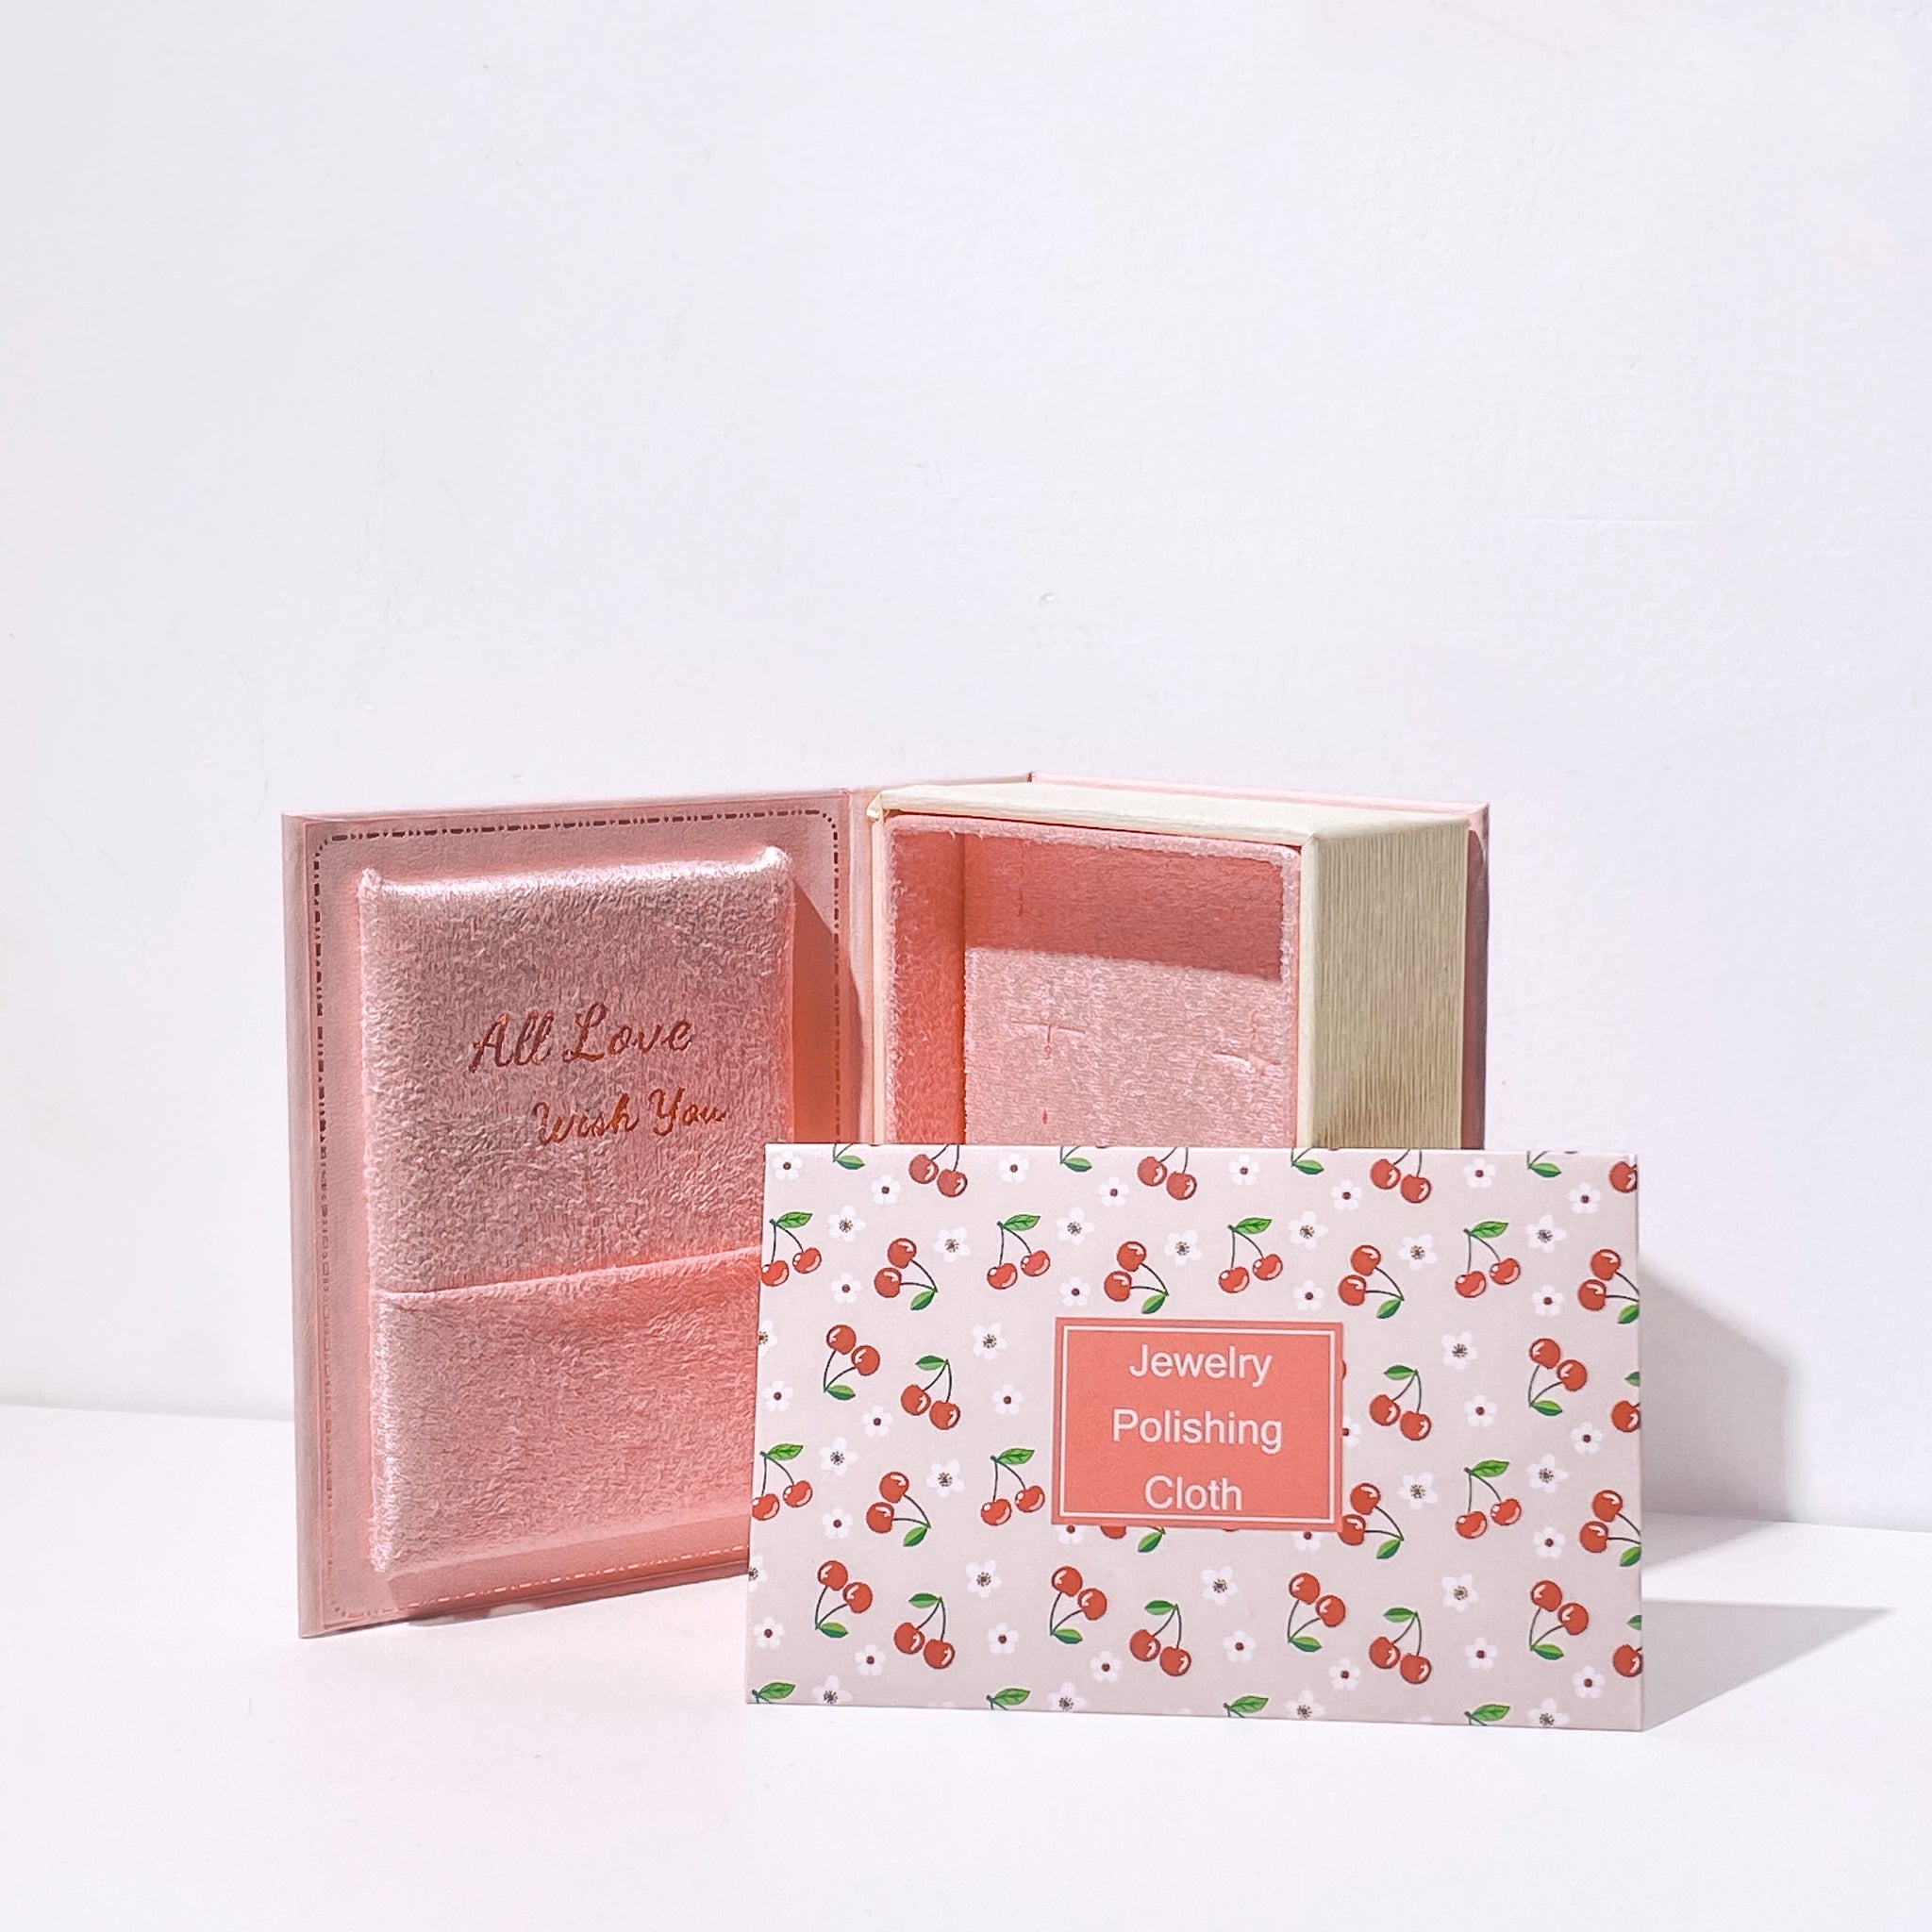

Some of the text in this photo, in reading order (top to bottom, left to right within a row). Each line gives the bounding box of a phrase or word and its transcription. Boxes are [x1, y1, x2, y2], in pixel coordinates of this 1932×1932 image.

[469, 1003, 693, 1074] All Love
[532, 1087, 726, 1145] Wish You
[1129, 1343, 1273, 1388] Jewelry
[1112, 1408, 1282, 1454] Polishing
[1144, 1474, 1243, 1510] Cloth
